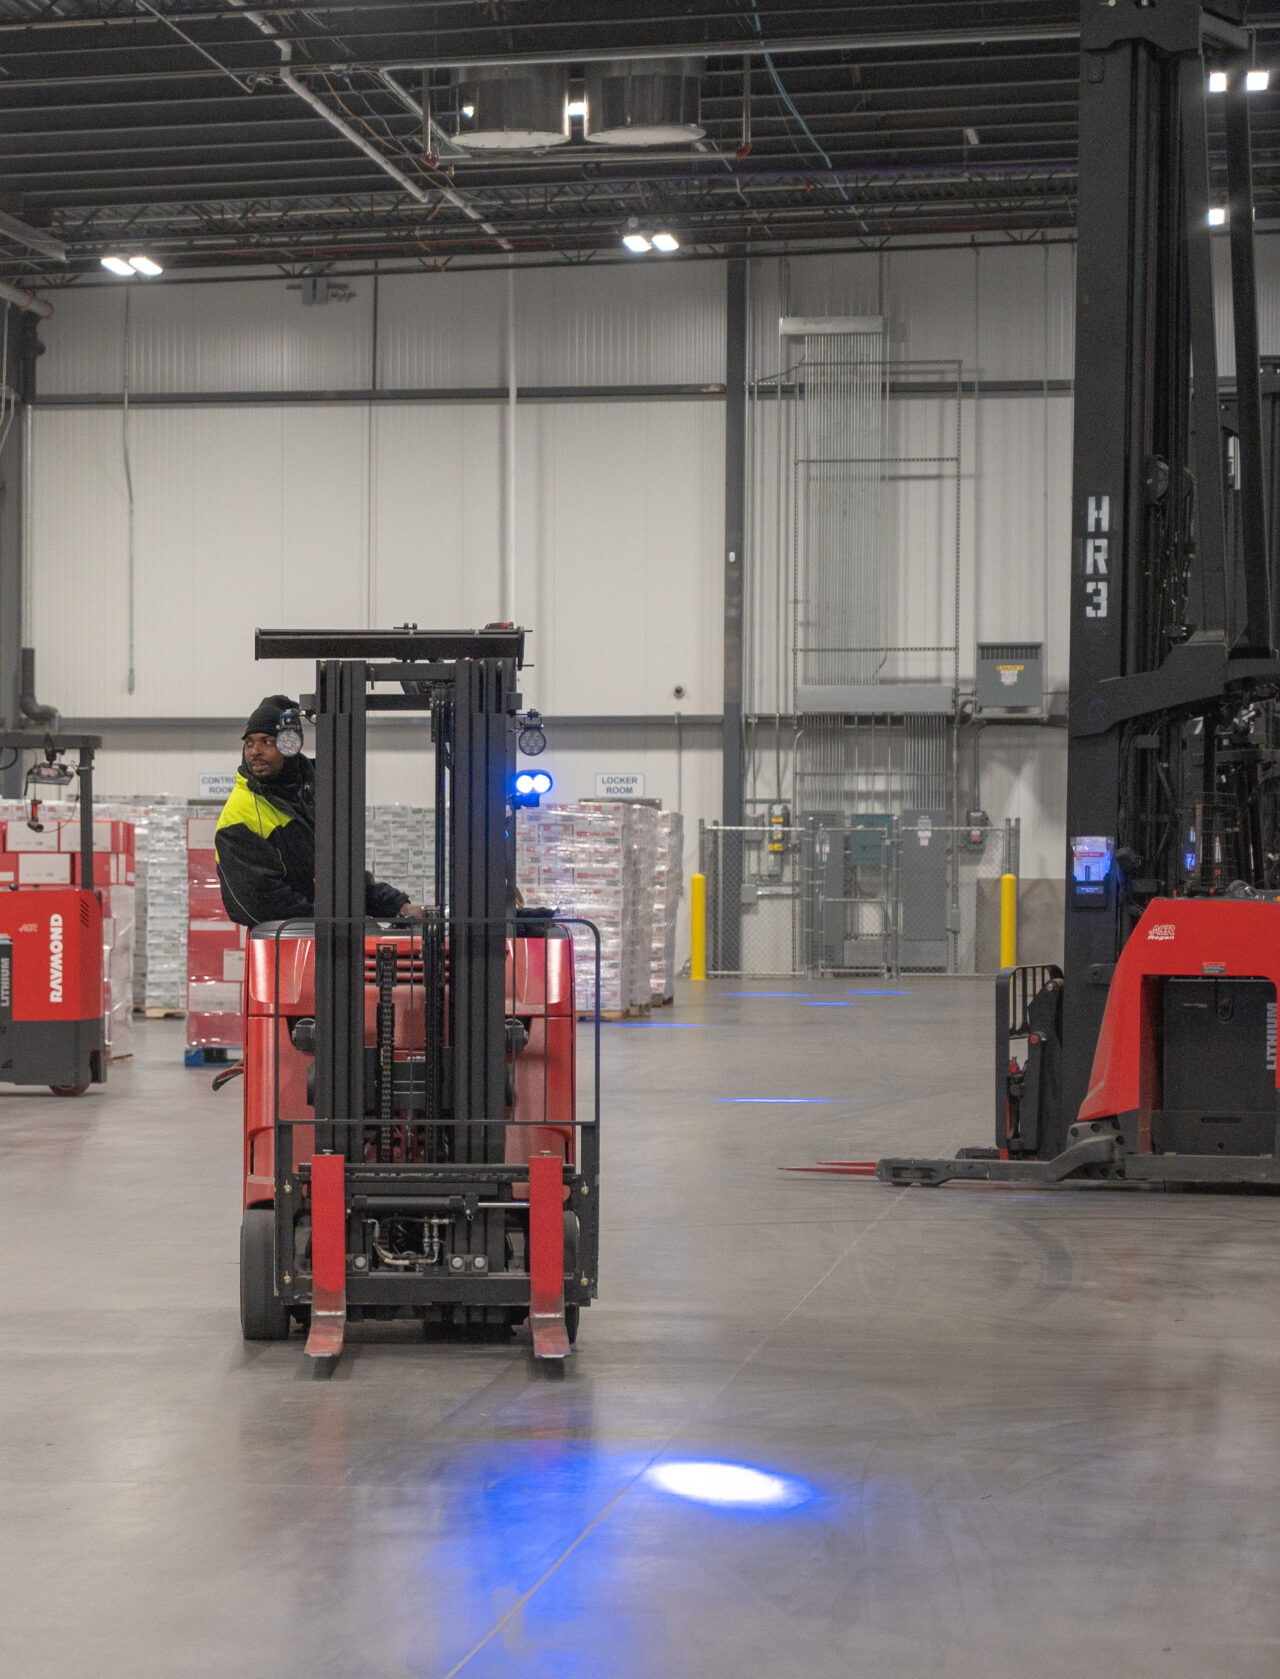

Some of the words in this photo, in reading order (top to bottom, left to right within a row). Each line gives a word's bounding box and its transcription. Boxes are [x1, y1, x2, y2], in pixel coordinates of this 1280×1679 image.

[1086, 495, 1109, 618] HR3
[201, 776, 237, 785] CONTRO
[601, 776, 639, 785] LOCKER
[606, 786, 634, 794] ROOM
[1148, 924, 1176, 936] ACR
[49, 912, 63, 1003] RAYMOND
[0, 957, 10, 1008] LITHIUM
[1266, 1002, 1277, 1070] LITHIUM
